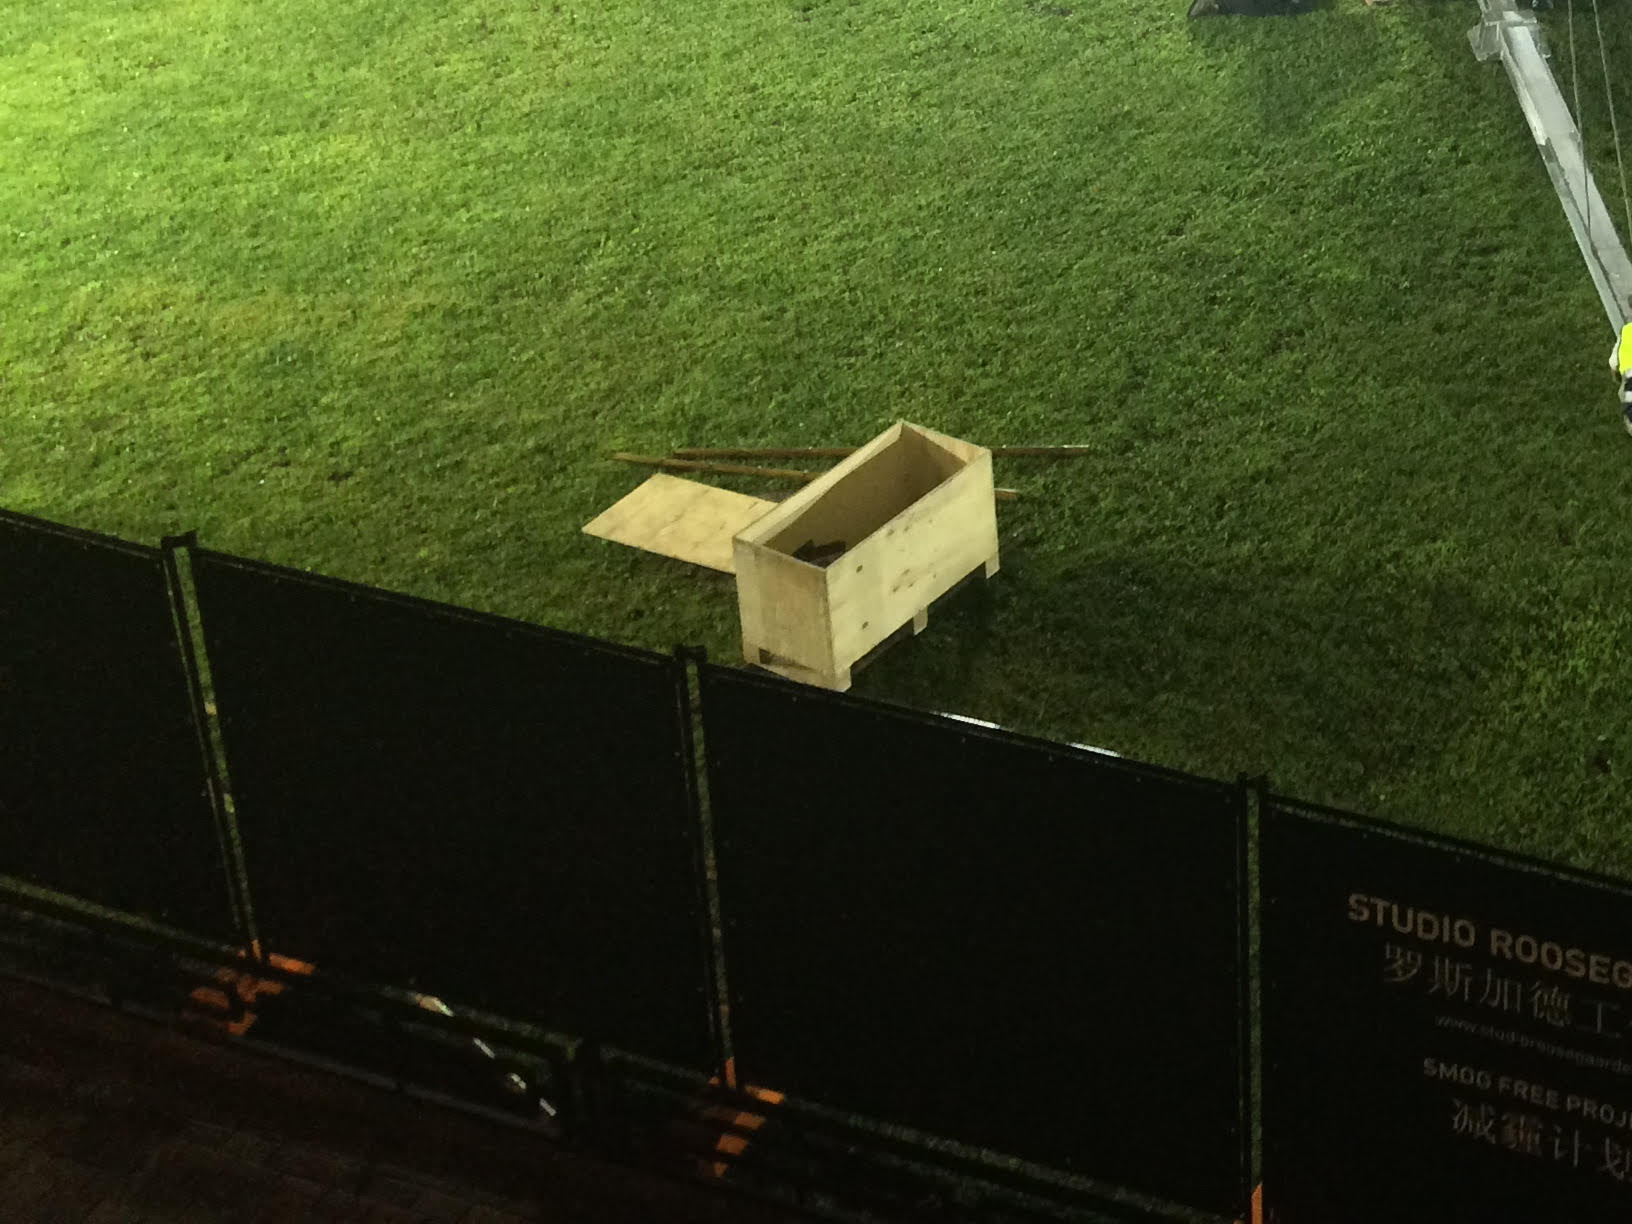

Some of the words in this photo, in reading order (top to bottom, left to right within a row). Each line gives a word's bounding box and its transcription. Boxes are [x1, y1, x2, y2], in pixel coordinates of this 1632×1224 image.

[1347, 893, 1477, 949] STUDIO
[1423, 1056, 1492, 1090] SMOG
[1497, 1076, 1561, 1111] FREE
